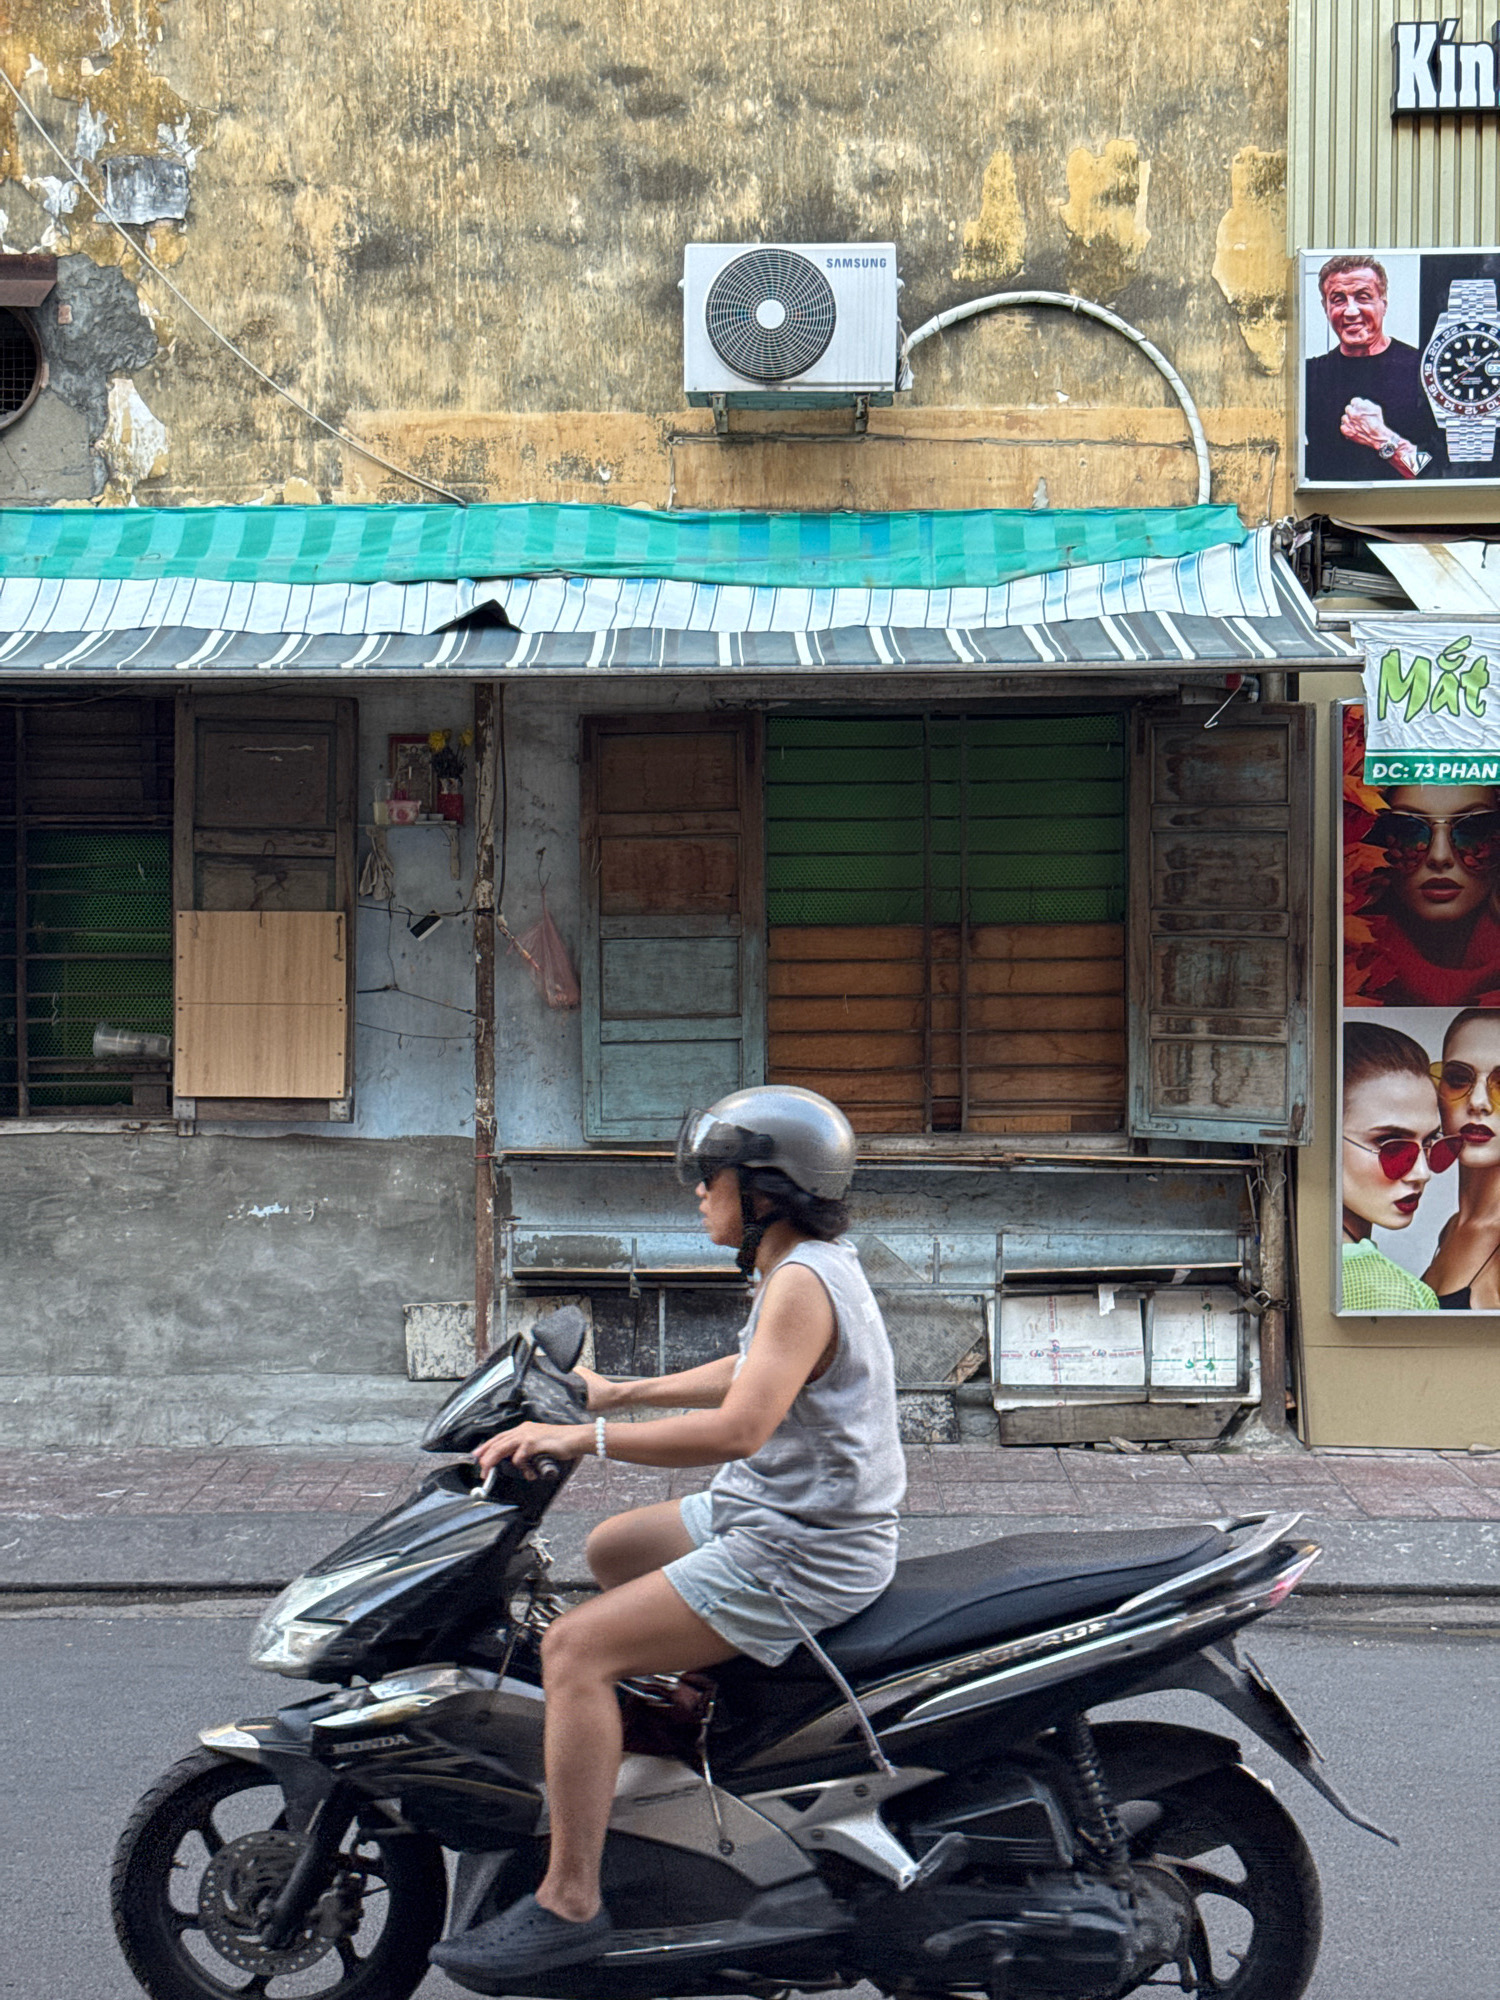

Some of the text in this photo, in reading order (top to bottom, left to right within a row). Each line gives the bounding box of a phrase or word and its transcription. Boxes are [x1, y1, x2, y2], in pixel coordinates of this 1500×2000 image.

[1392, 18, 1500, 112] Kín
[826, 257, 887, 269] SAMSUNG
[1442, 326, 1459, 340] 22
[1428, 340, 1441, 356] 20
[1464, 406, 1479, 415] 12
[1377, 635, 1490, 723] Mắt
[1414, 763, 1435, 778] 73
[1438, 763, 1499, 779] PHAN
[332, 1734, 410, 1754] HONDA
